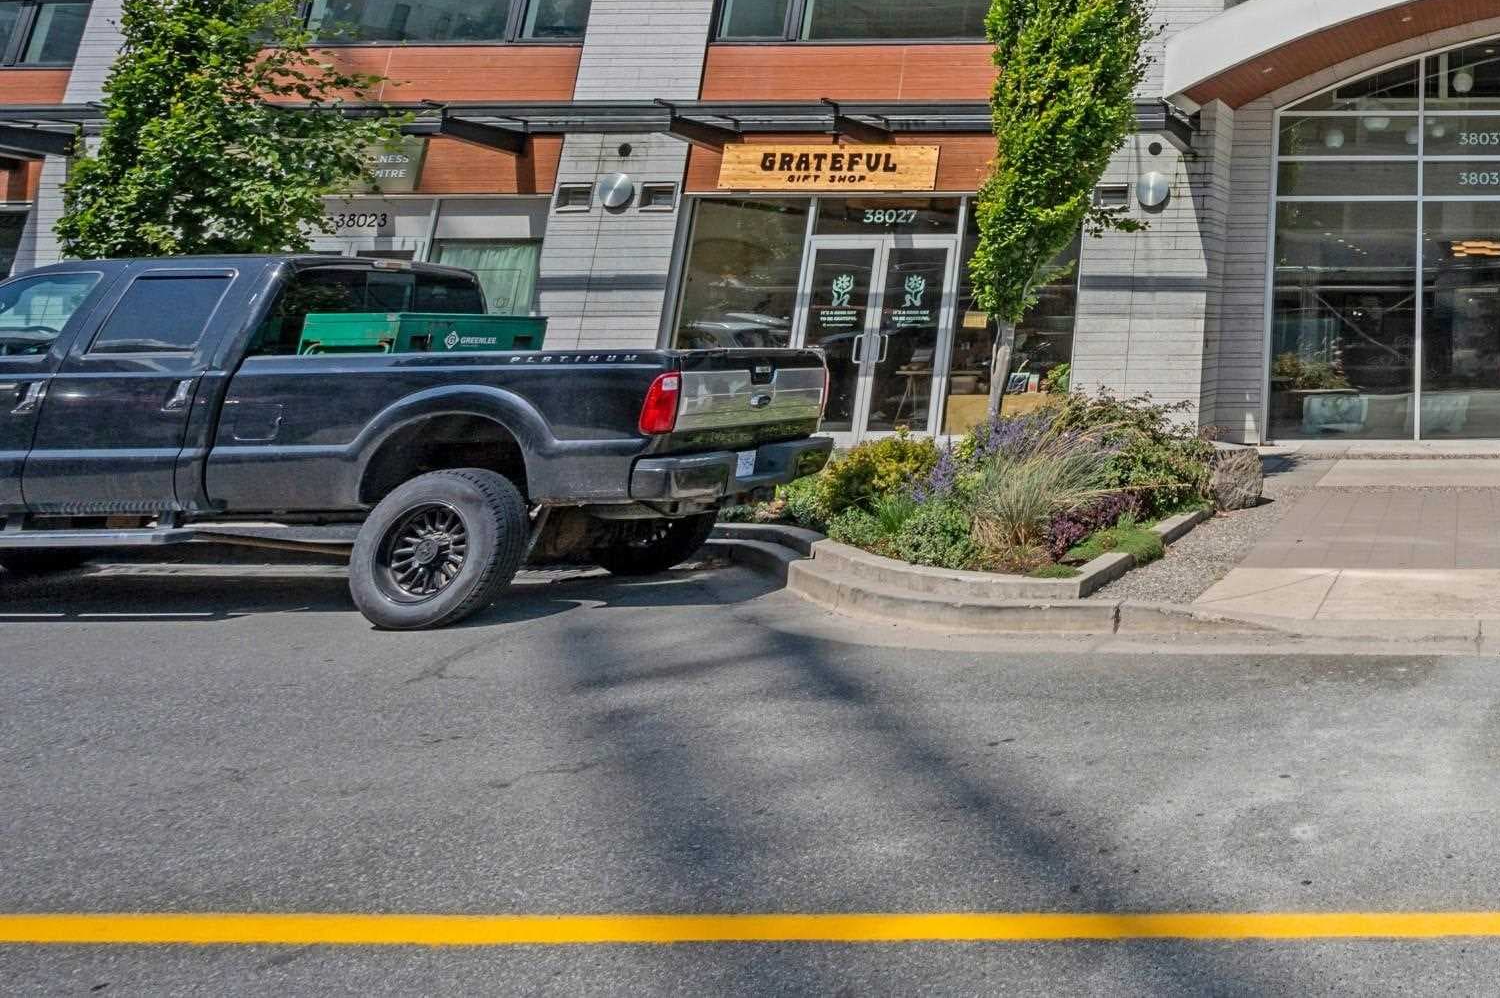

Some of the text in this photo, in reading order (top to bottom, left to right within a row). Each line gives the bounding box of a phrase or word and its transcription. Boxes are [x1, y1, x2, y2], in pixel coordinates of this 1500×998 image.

[760, 152, 897, 173] GRATEFUL
[787, 174, 867, 183] GIFT SHOP
[336, 213, 387, 227] 38023
[863, 209, 918, 224] 38027
[460, 336, 497, 344] GREENLEE
[510, 354, 638, 363] PLATINUM
